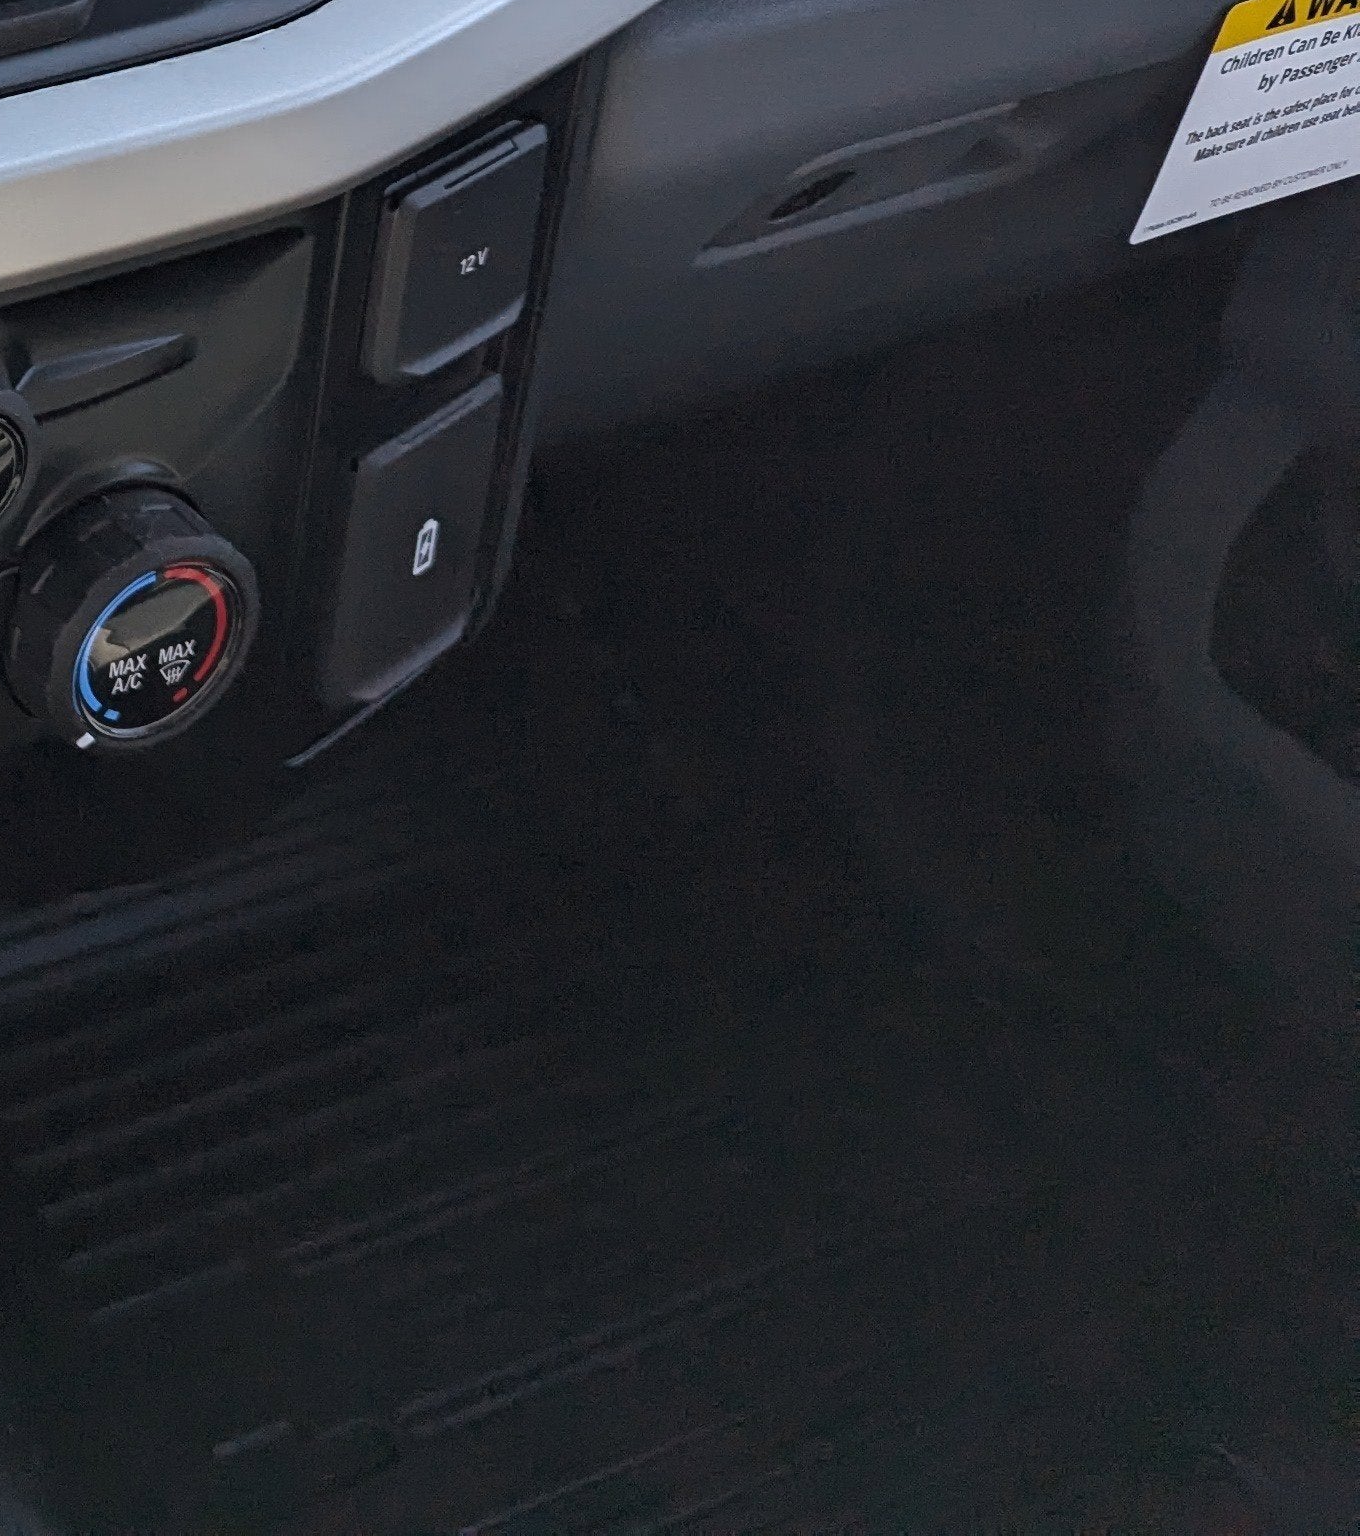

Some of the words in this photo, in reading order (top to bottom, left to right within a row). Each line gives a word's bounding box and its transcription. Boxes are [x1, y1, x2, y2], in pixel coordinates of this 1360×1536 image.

[1220, 46, 1285, 75] Children
[1287, 37, 1318, 56] Can
[1319, 30, 1341, 47] Be
[1257, 73, 1279, 93] by
[1280, 52, 1358, 84] Passenger
[159, 639, 197, 664] MAX
[109, 653, 149, 679] MAX
[111, 673, 143, 696] A/C
